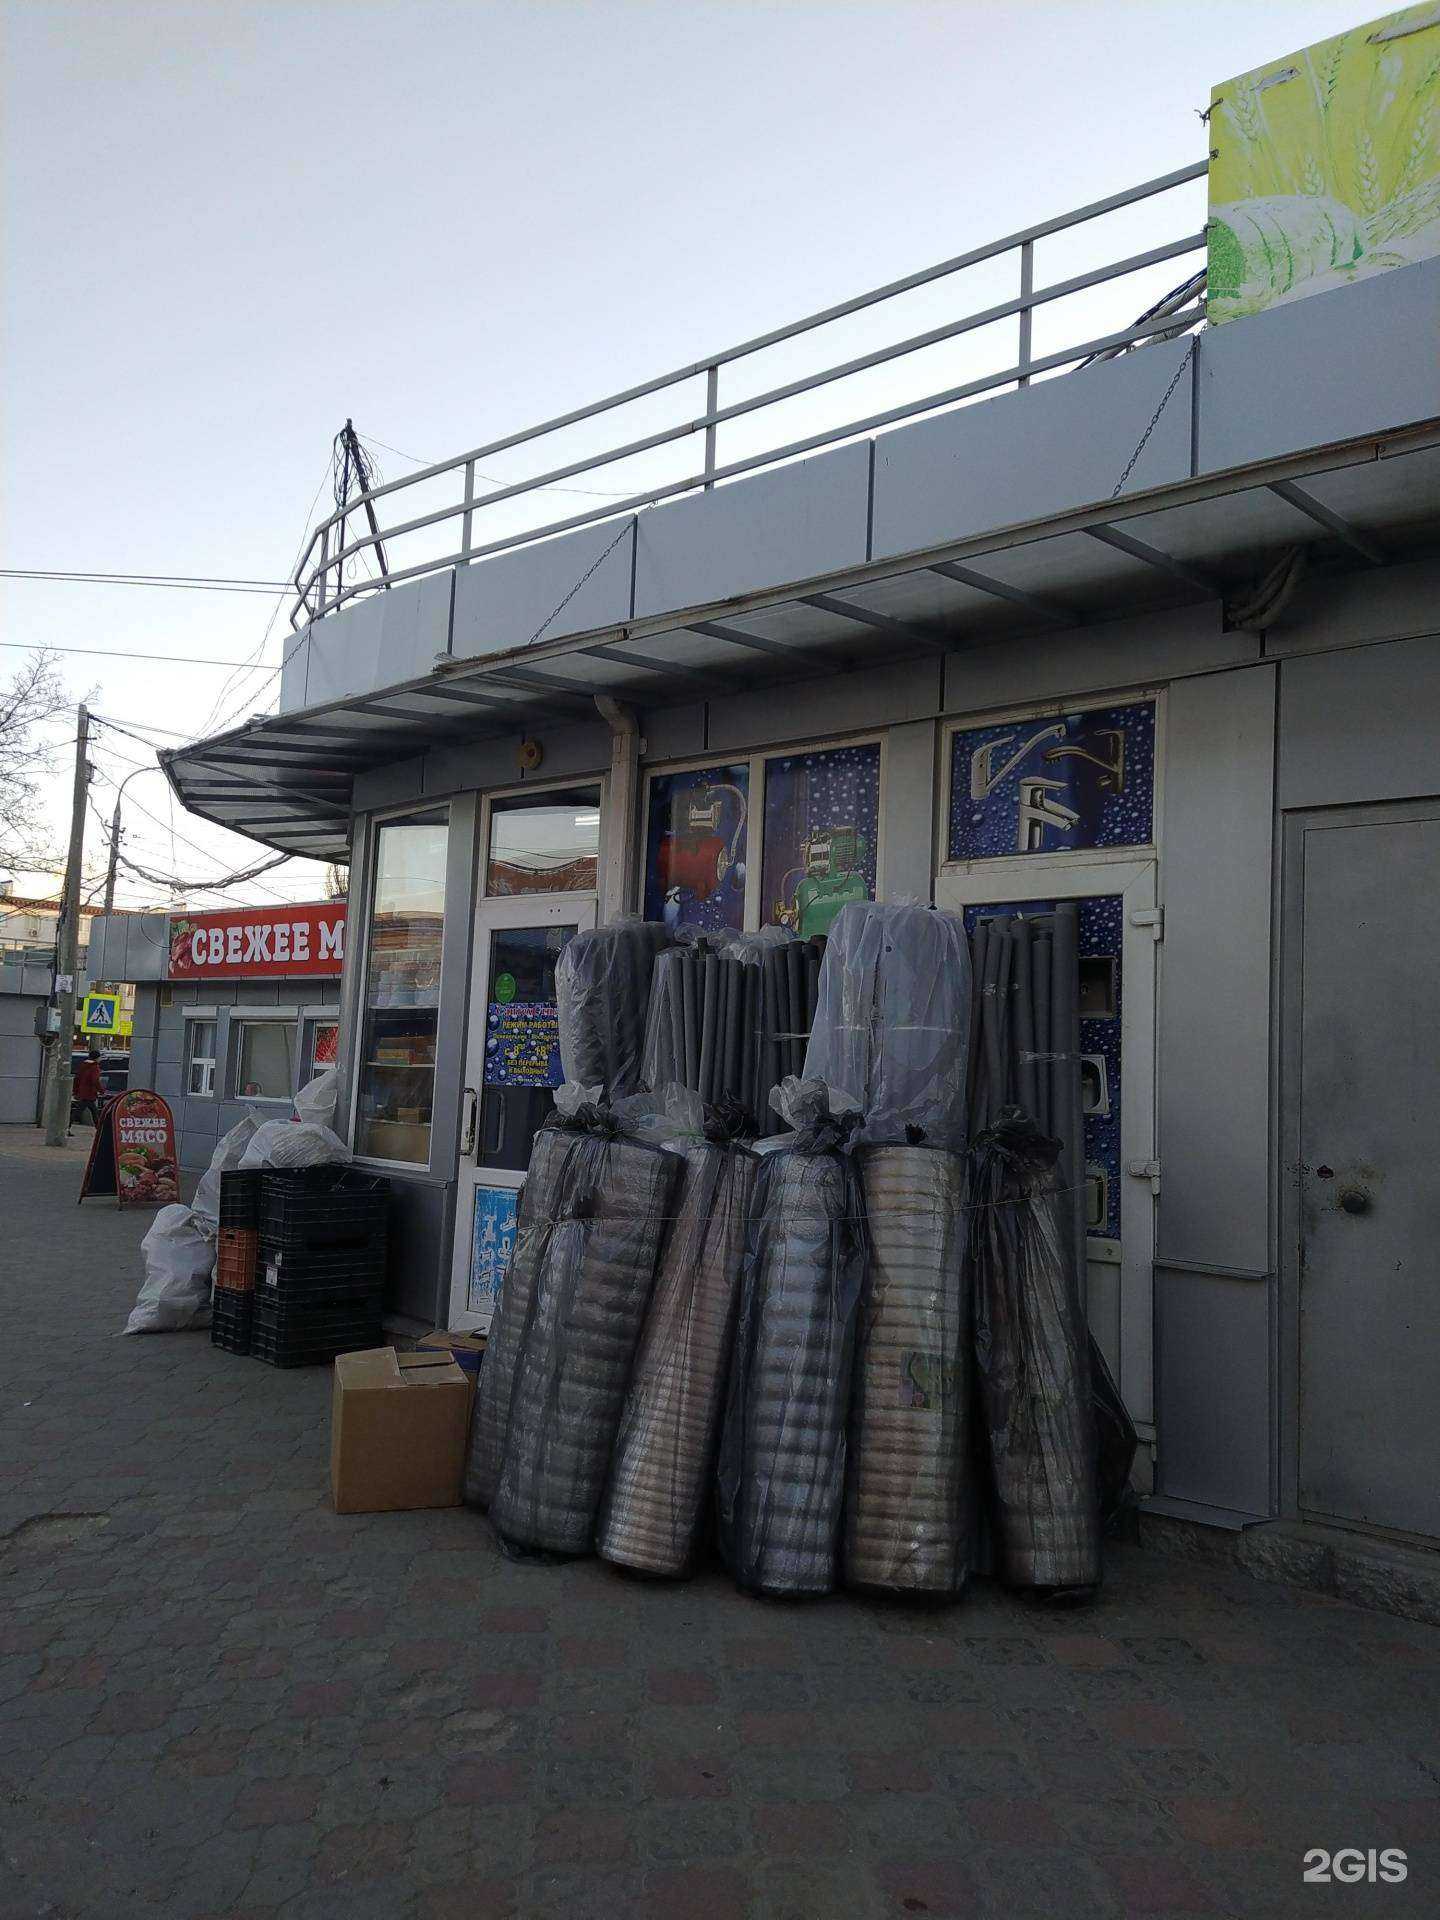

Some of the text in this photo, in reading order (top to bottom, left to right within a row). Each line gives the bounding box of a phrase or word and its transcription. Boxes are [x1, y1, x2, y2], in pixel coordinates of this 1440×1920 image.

[192, 922, 310, 966] СВЕЖЕЕ
[119, 1117, 168, 1128] СВЕЖЕЕ
[120, 1129, 167, 1143] МЯСО
